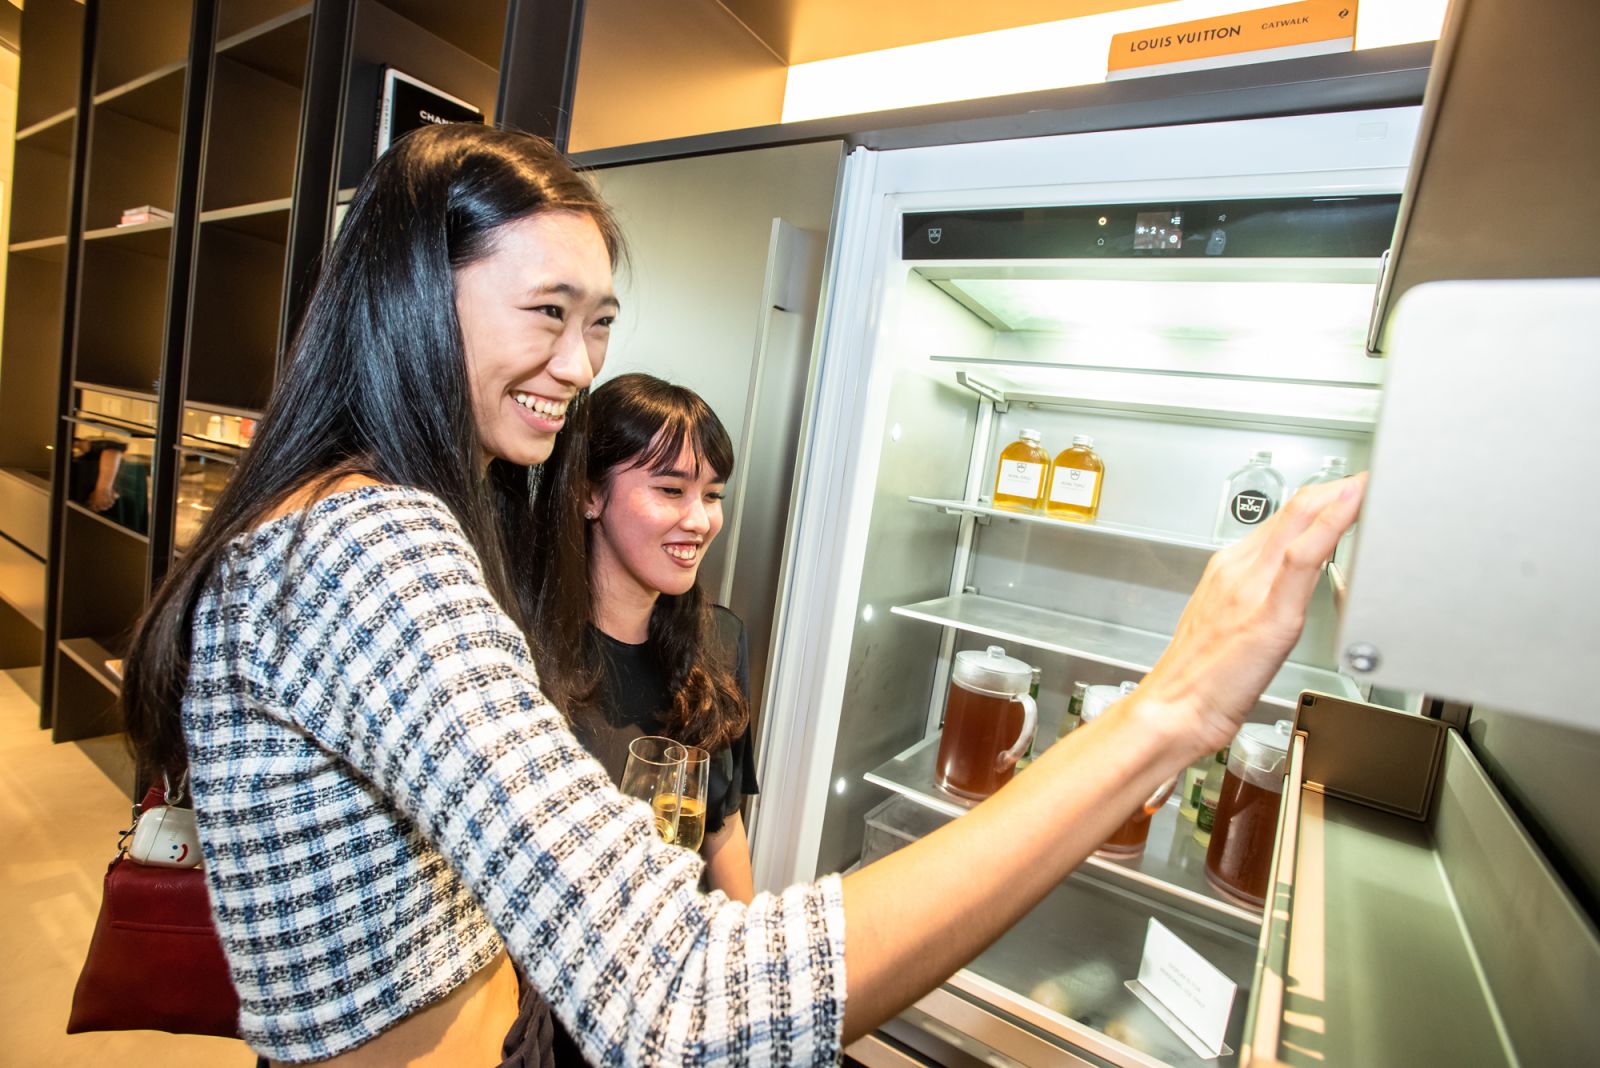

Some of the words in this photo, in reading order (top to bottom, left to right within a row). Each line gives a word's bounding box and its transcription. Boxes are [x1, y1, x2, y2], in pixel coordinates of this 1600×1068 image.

[1130, 36, 1171, 52] LOUIS
[1177, 25, 1241, 45] VUITTON
[1261, 16, 1309, 30] CATWALK
[420, 110, 455, 125] CHAN
[1240, 503, 1261, 513] ZUG
